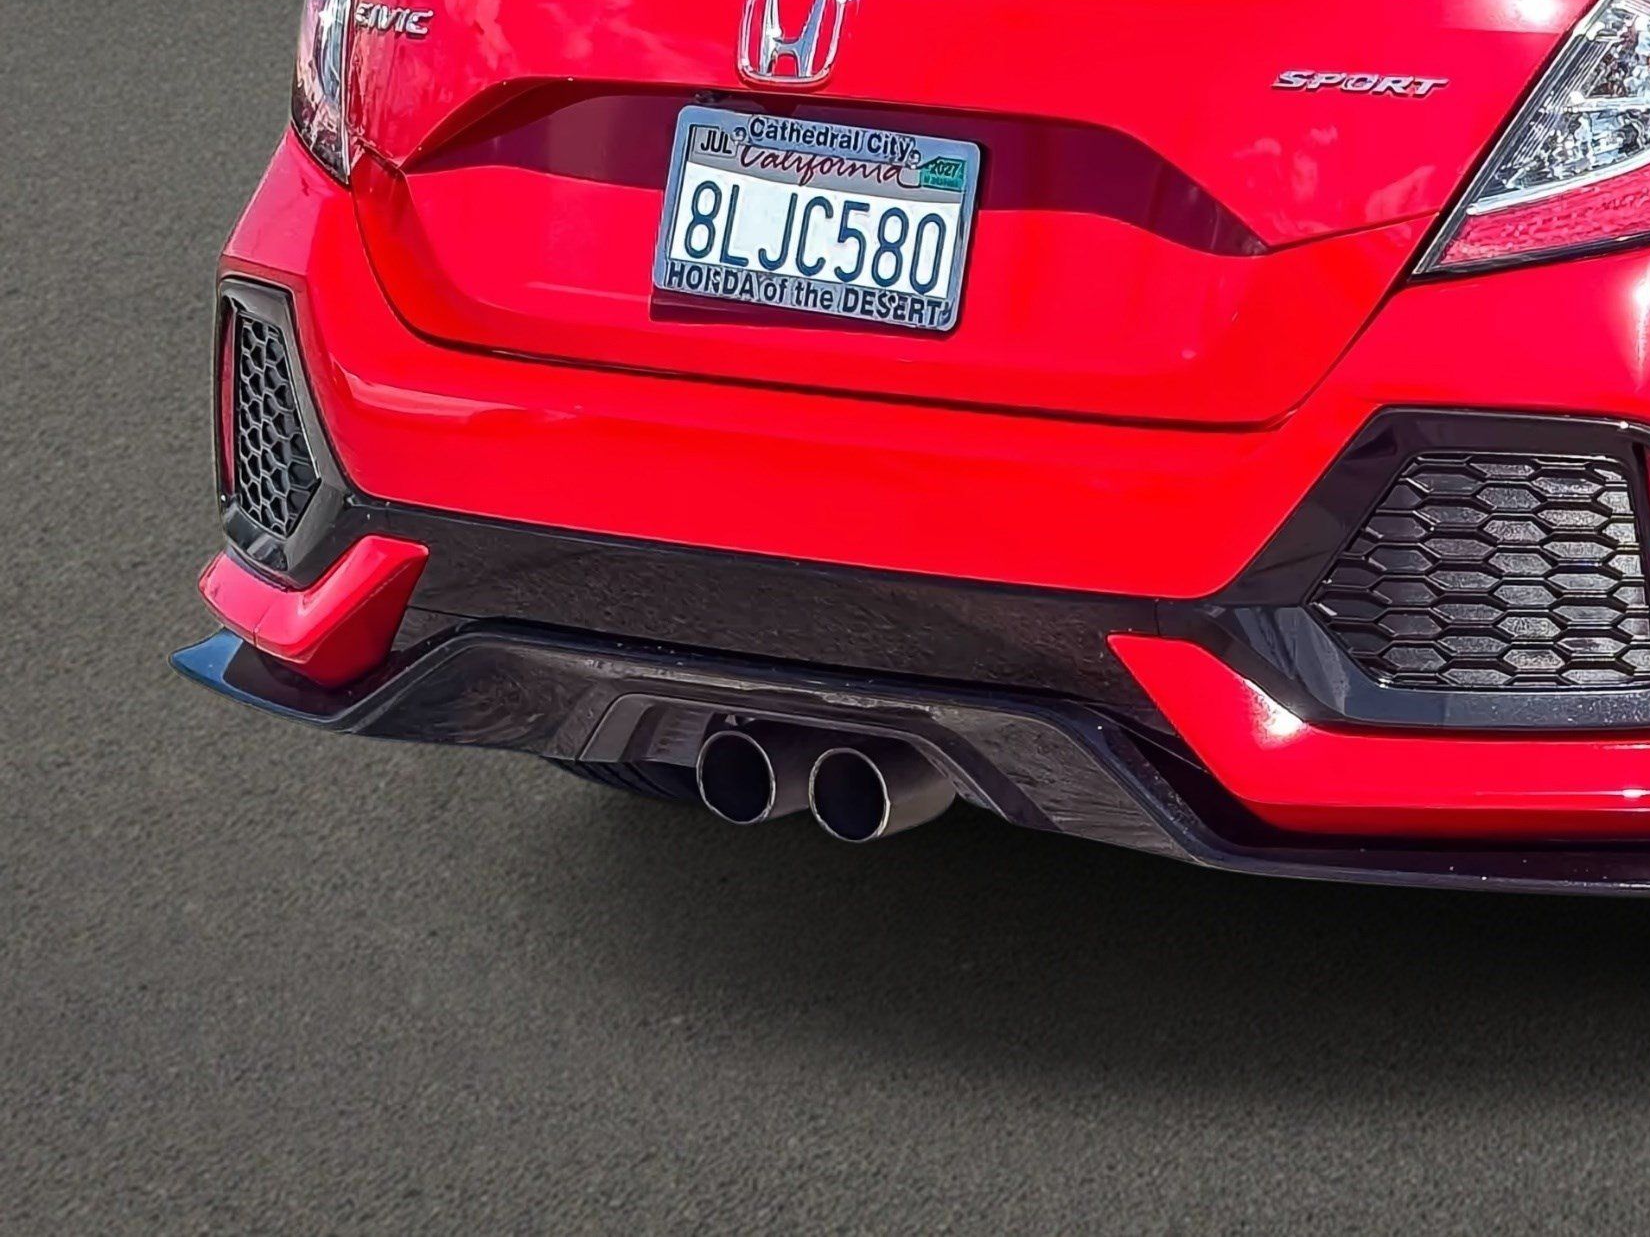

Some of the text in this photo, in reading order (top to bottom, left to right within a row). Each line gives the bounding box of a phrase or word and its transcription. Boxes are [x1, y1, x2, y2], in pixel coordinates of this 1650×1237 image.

[1272, 70, 1450, 96] SPORT
[701, 129, 733, 155] JUL
[750, 117, 912, 162] Cathedral City
[740, 145, 903, 186] California
[684, 180, 947, 294] 8LJC580
[665, 261, 942, 326] HONDA of the DESERT
